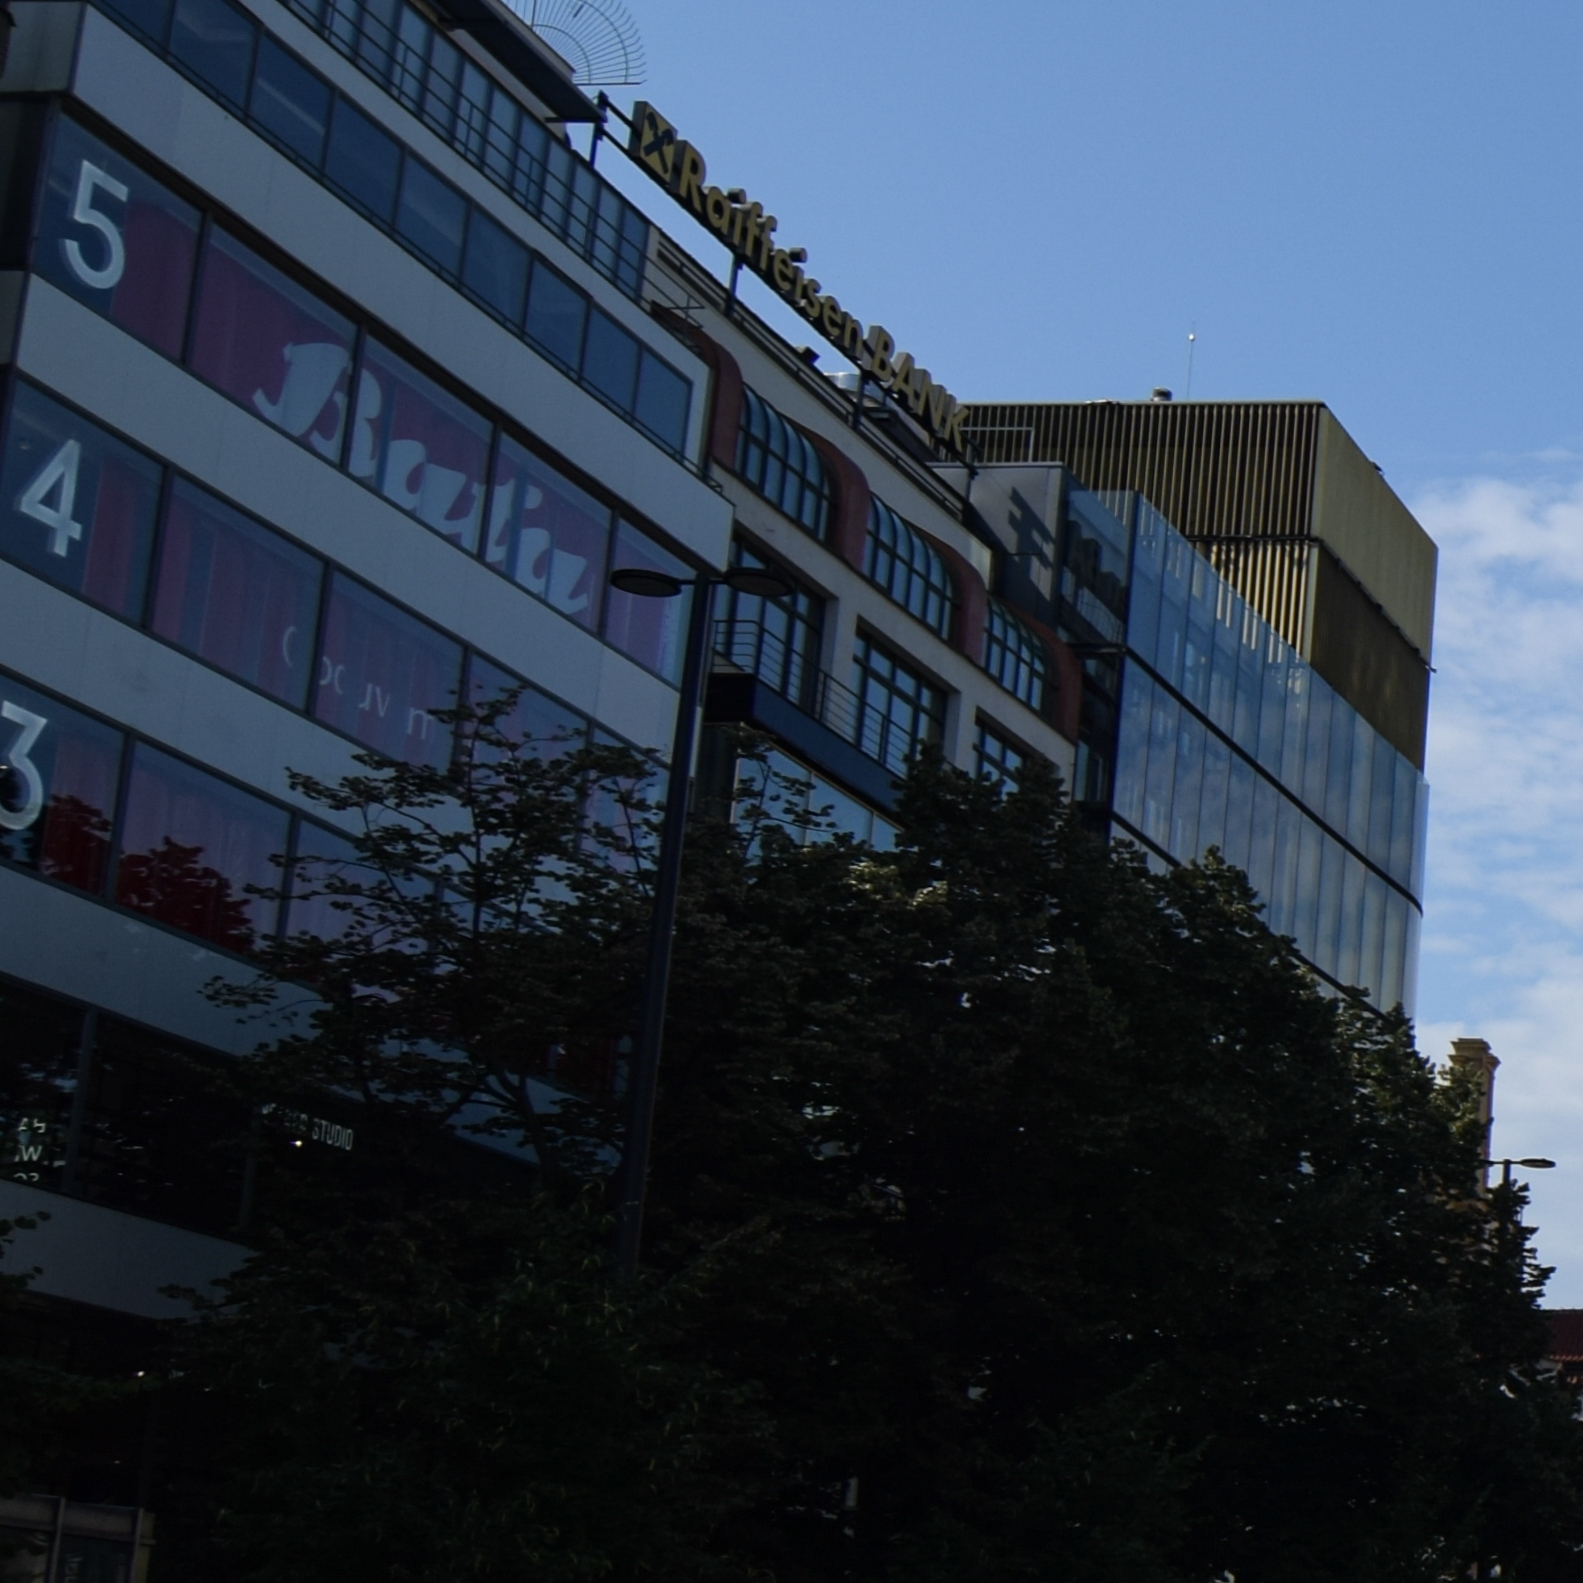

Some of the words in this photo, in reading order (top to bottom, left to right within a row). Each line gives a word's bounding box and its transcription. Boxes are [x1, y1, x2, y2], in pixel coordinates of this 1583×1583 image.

[64, 158, 130, 290] 5
[675, 140, 866, 360] Raiffeisen
[868, 325, 970, 453] BANK
[19, 438, 83, 558] 4
[0, 701, 48, 831] 3
[312, 1117, 354, 1151] STUDIO
